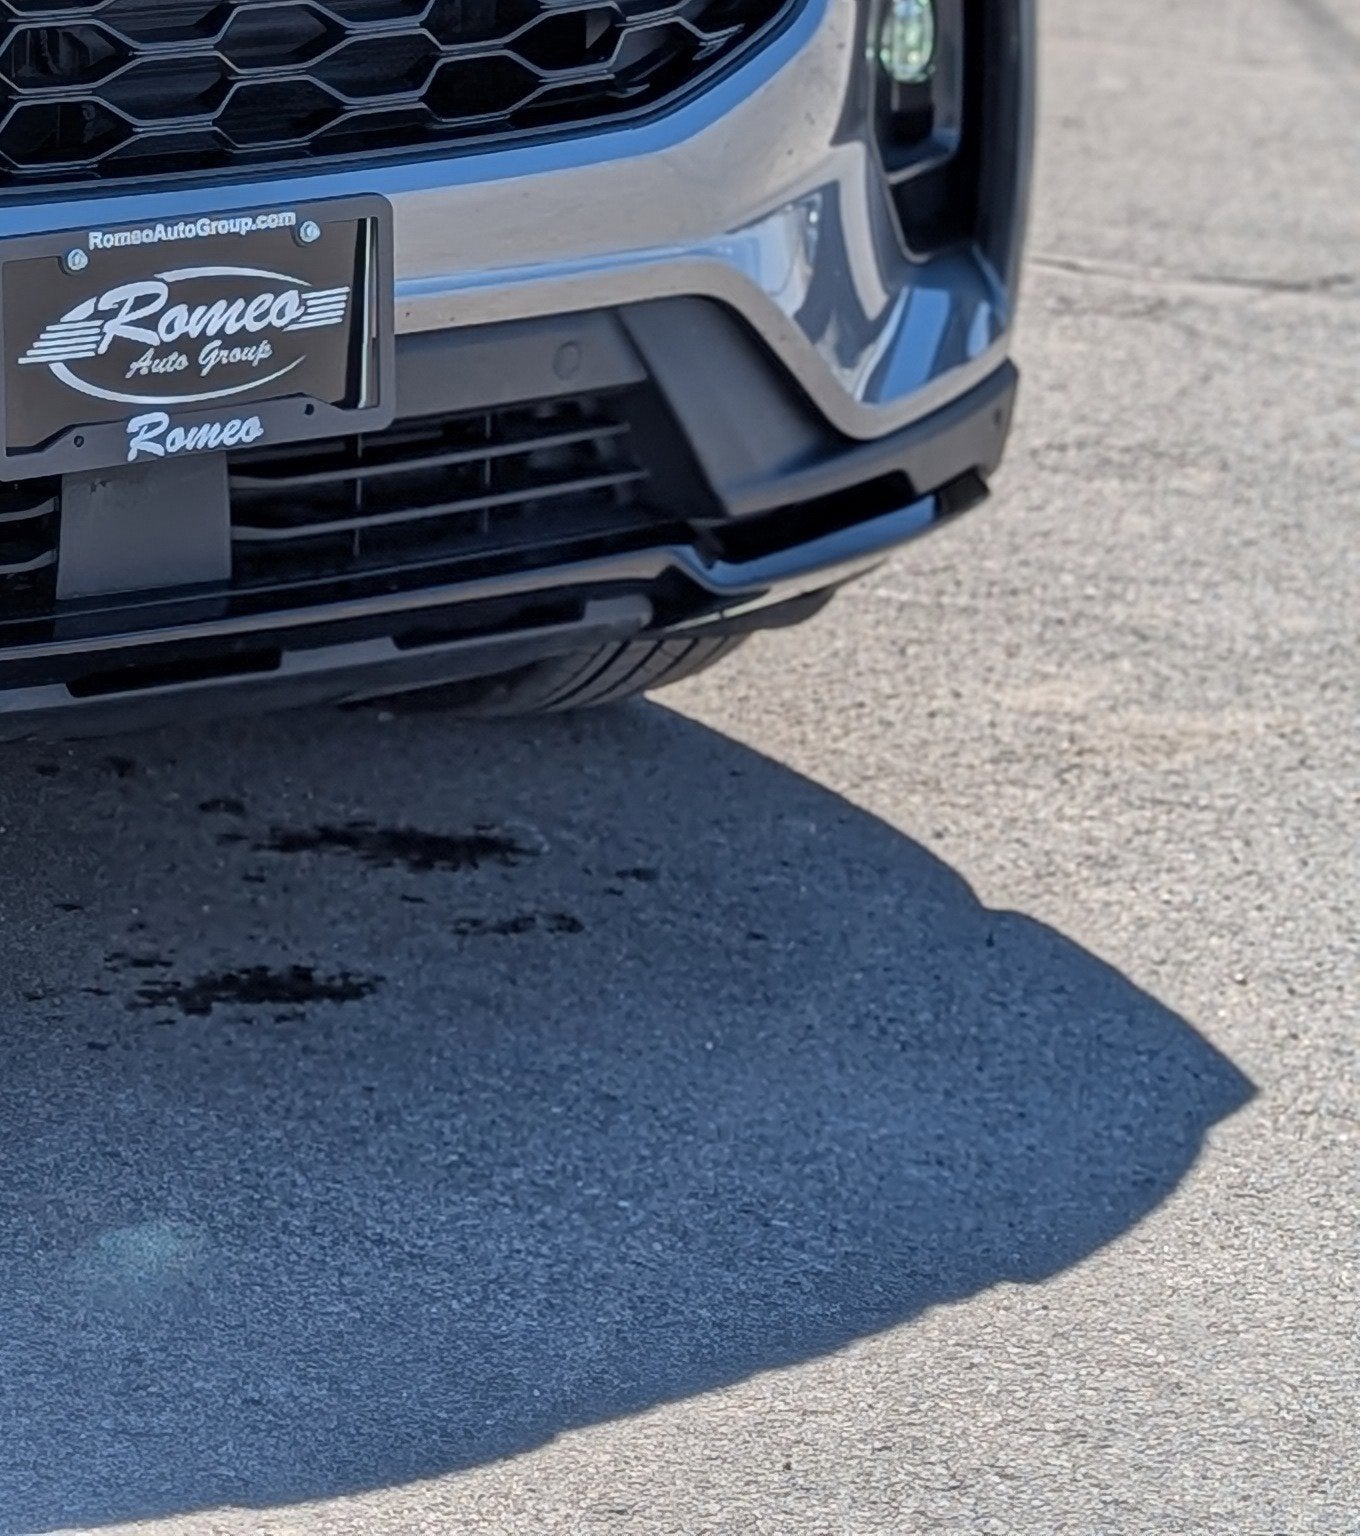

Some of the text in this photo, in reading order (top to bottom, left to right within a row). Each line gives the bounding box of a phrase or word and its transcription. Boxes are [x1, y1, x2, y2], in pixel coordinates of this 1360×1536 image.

[88, 212, 297, 251] RomeoAutoGroup.com
[97, 280, 307, 356] Romeo
[125, 339, 273, 379] Auto Group
[125, 411, 265, 462] Romeo
